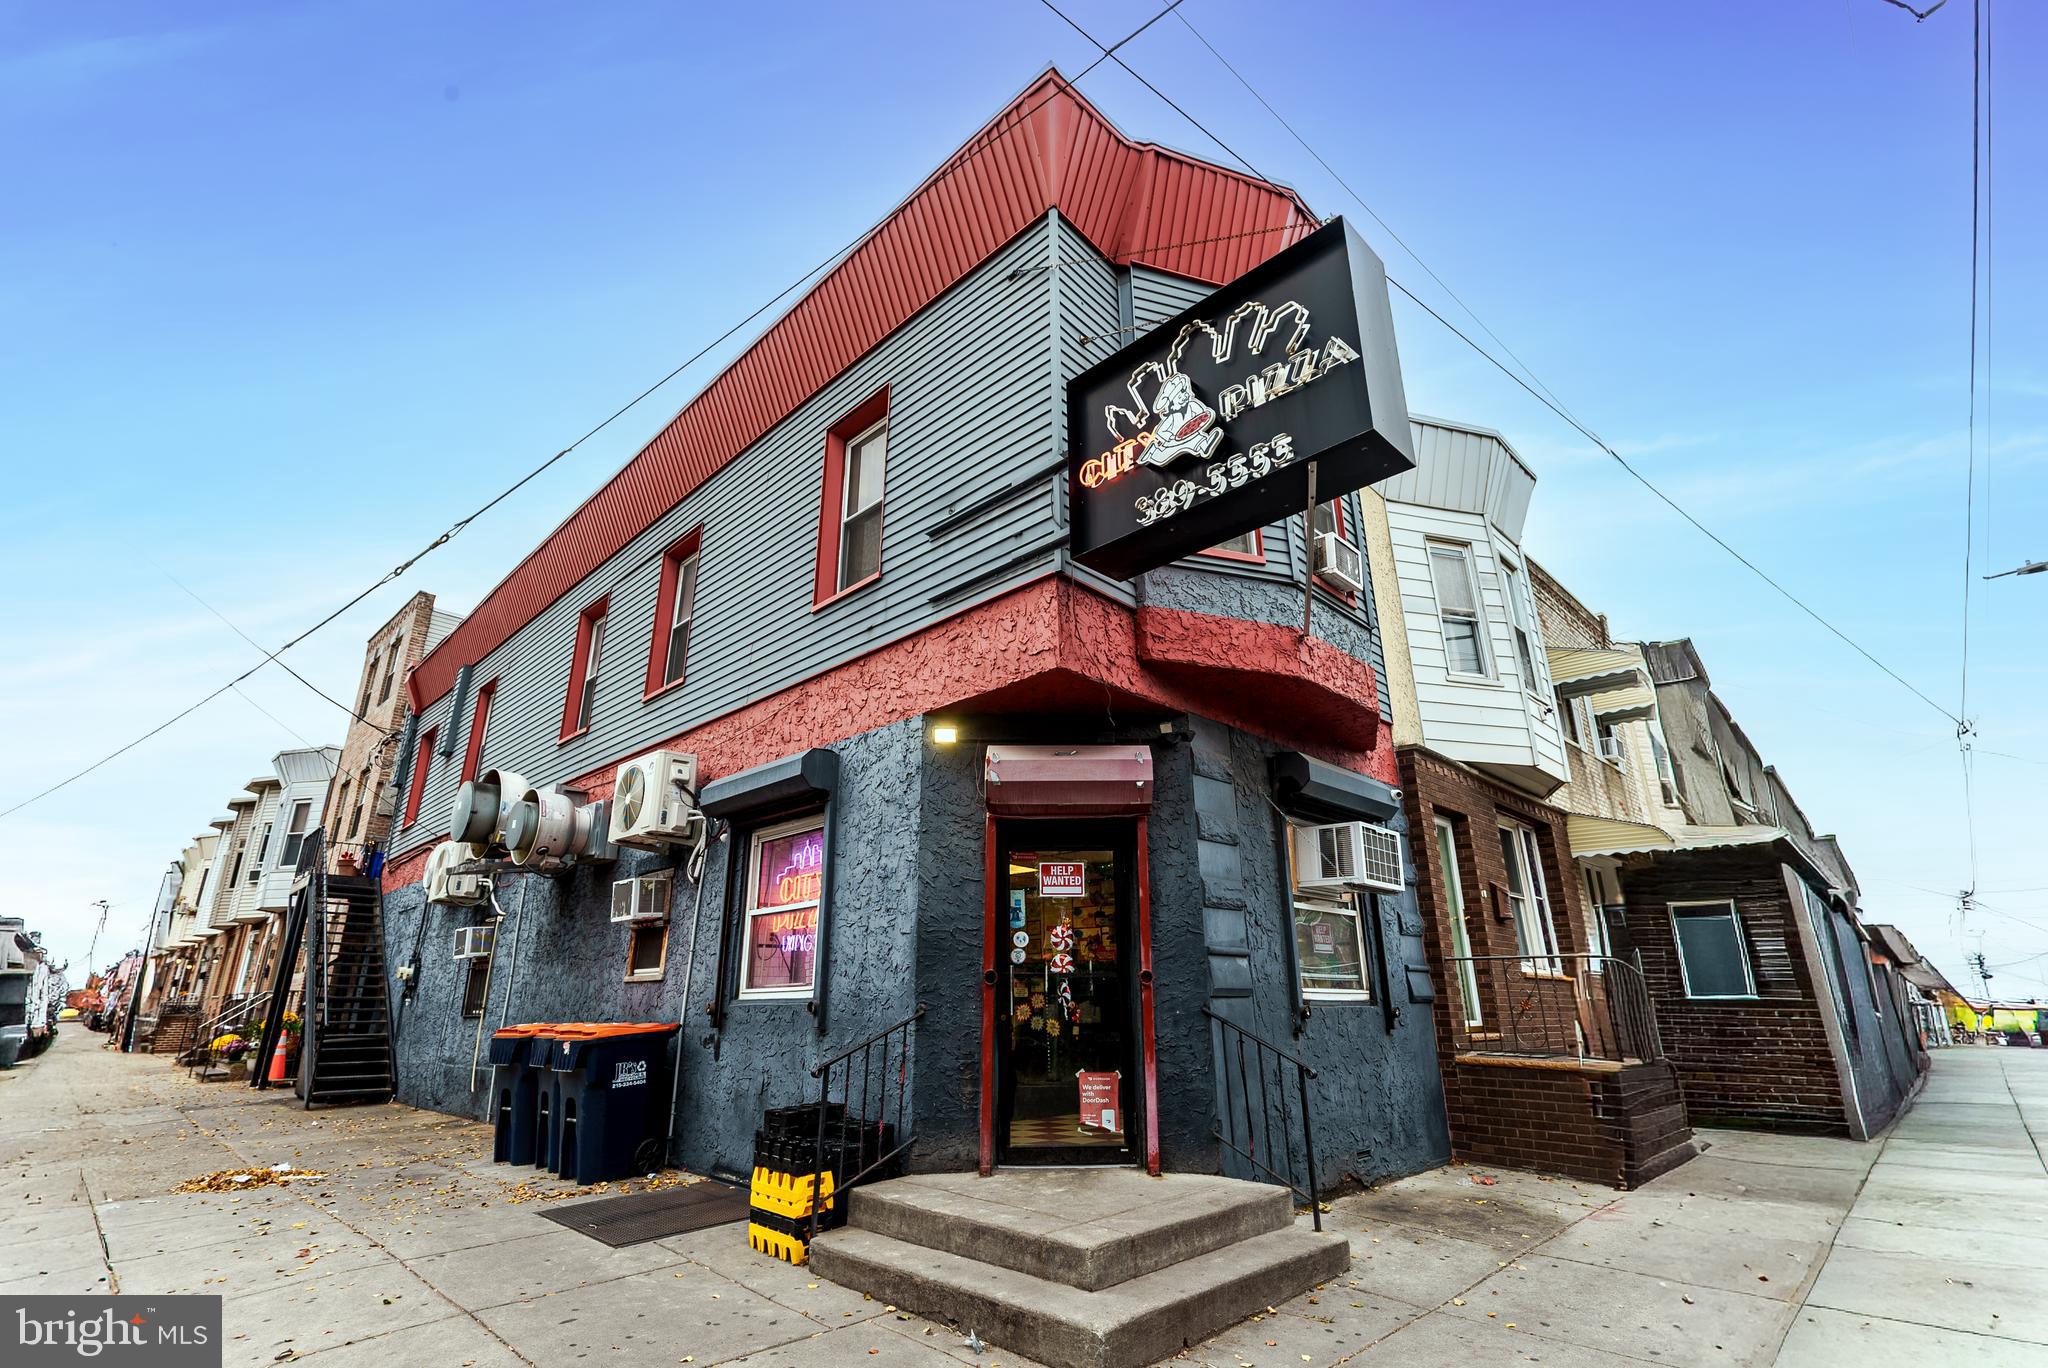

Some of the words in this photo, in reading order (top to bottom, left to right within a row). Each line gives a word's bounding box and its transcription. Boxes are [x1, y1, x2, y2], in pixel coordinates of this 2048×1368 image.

[1218, 335, 1360, 422] PIZZA
[1135, 432, 1296, 527] 389-5555
[1042, 875, 1081, 886] WANTED
[1050, 865, 1074, 876] HELP
